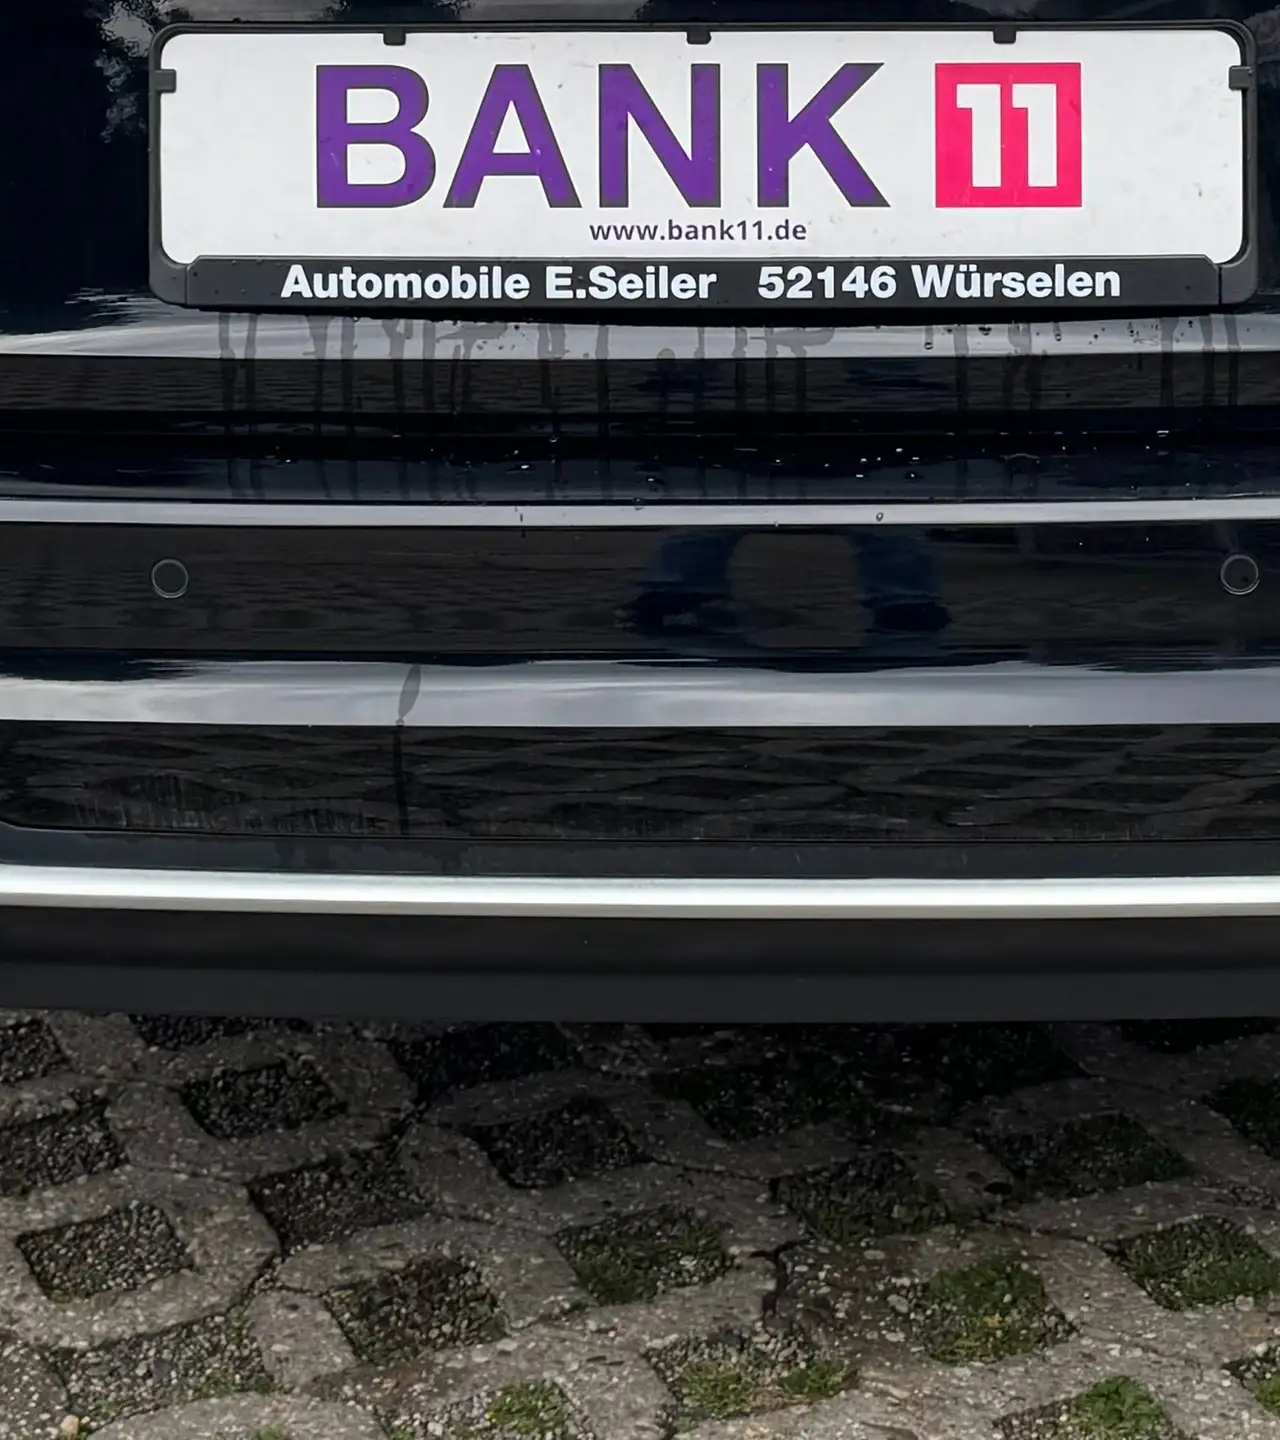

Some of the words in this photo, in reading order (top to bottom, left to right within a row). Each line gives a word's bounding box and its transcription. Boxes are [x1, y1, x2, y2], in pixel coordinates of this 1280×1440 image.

[316, 63, 891, 209] BANK
[954, 81, 1060, 190] 11
[589, 218, 807, 242] www.bank11.de
[280, 264, 531, 300] Automobile
[545, 265, 717, 300] E.Seiler
[757, 264, 897, 300] 52146
[910, 263, 1121, 300] Würselen
